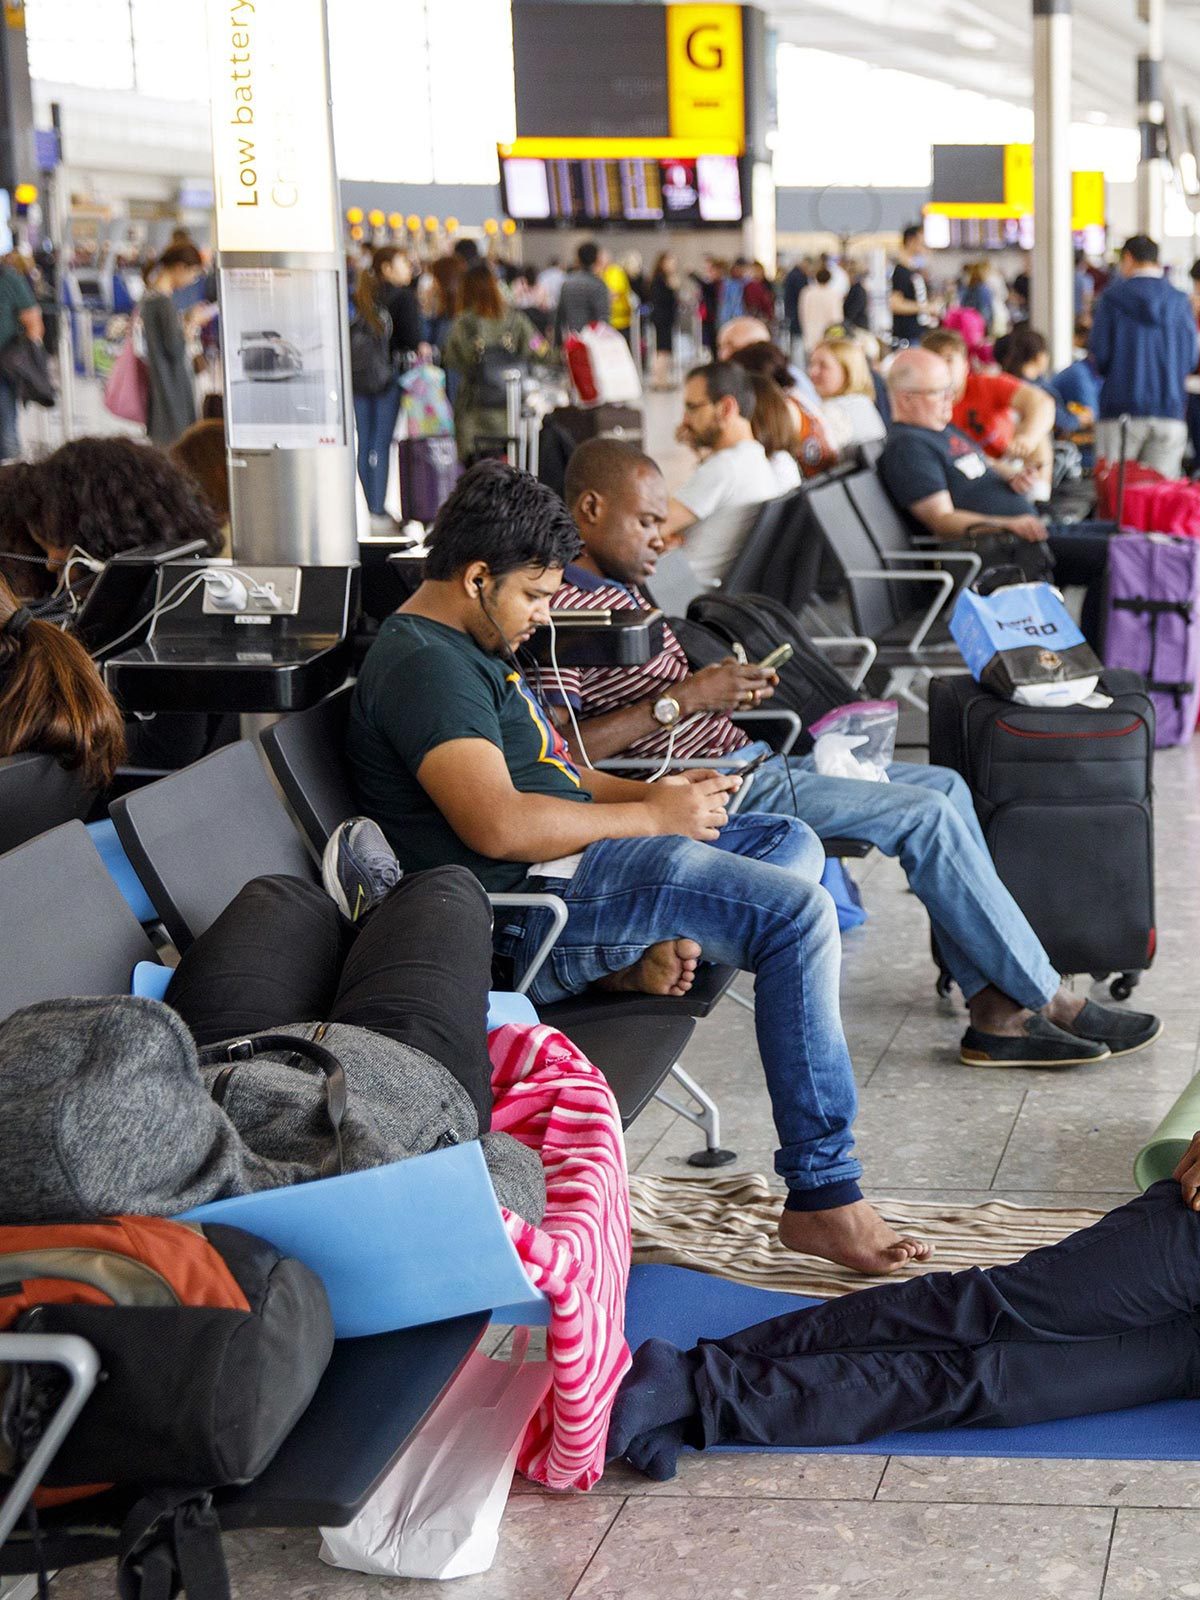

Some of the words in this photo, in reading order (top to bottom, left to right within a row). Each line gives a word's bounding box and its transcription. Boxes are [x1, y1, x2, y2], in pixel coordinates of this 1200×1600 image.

[230, 0, 255, 124] battery
[686, 24, 722, 71] G
[237, 138, 258, 206] Low
